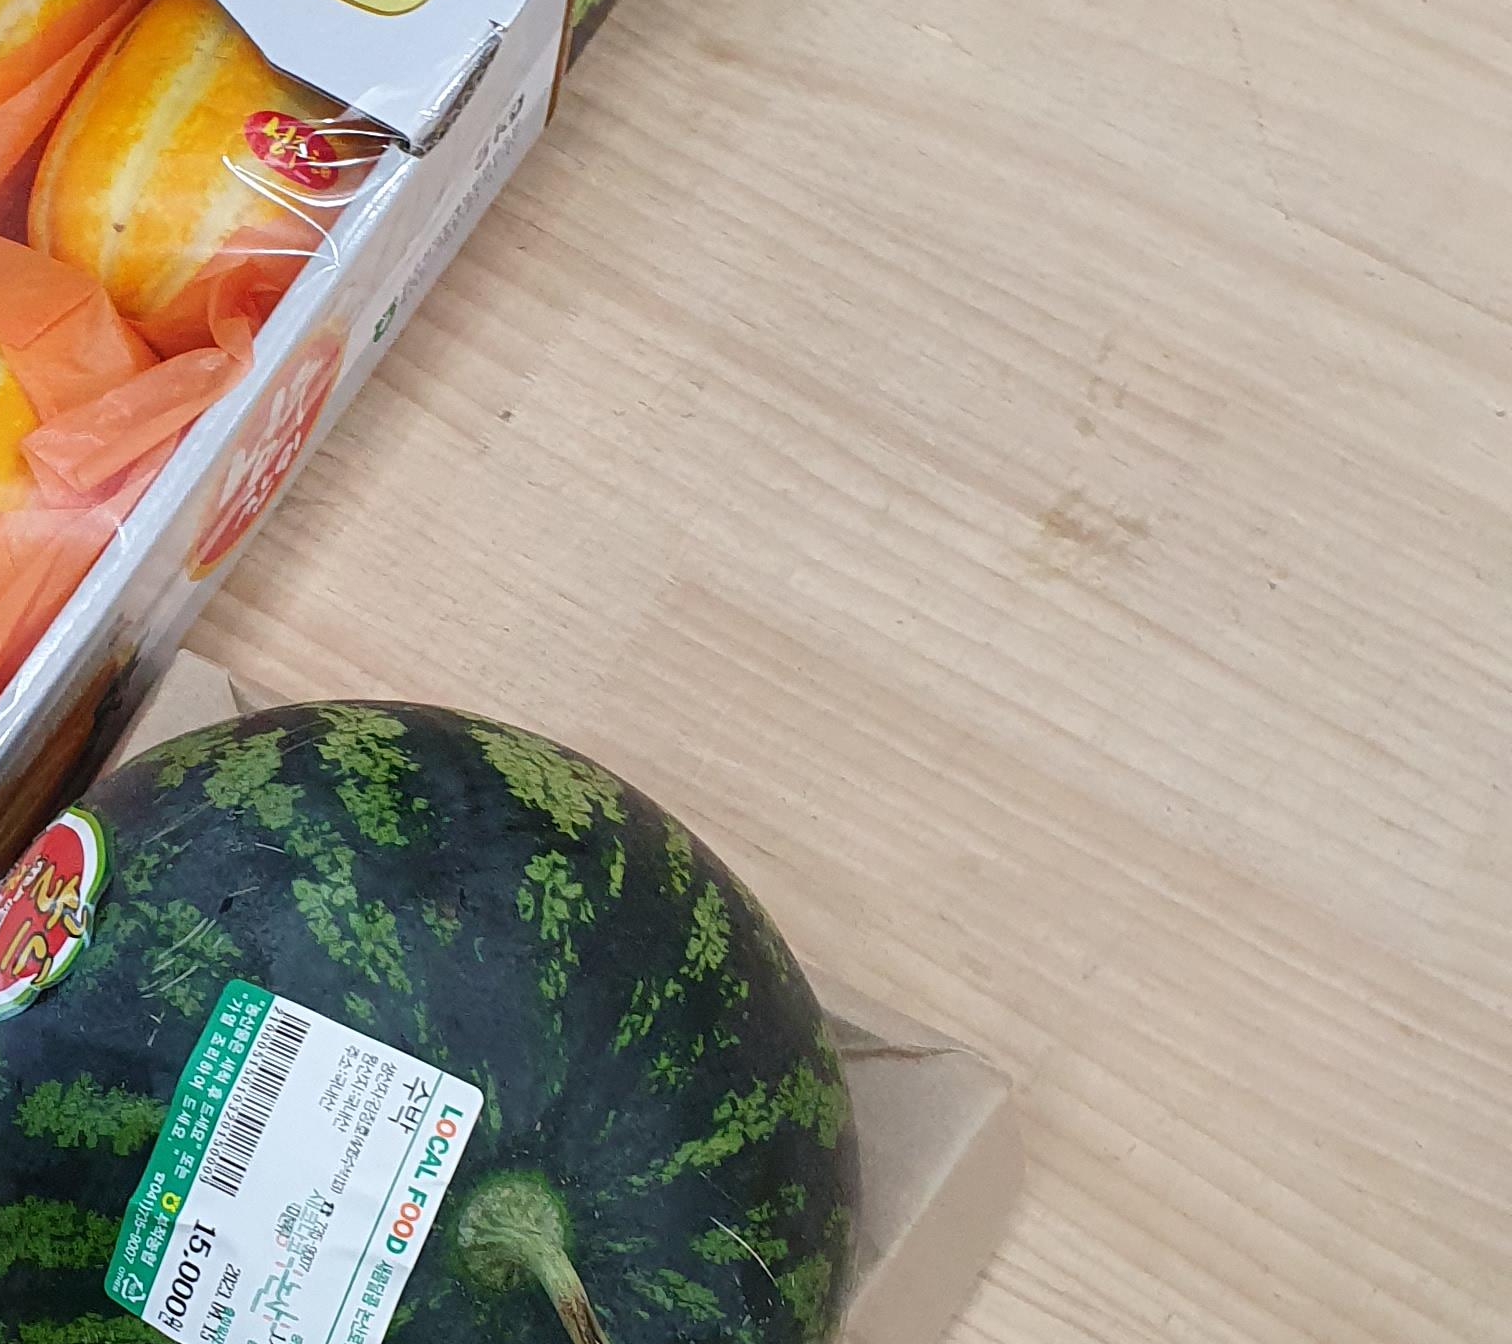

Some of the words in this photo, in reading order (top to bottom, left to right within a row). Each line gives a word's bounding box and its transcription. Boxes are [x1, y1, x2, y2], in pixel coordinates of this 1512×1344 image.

[318, 1043, 357, 1112] 주소:국내산
[332, 1051, 376, 1133] 원산지:국내산
[386, 1072, 433, 1135] 수박
[173, 1151, 194, 1180] 또는
[413, 1103, 462, 1184] LOCAL
[383, 1186, 427, 1256] FOOD
[157, 1219, 219, 1330] 15,000원
